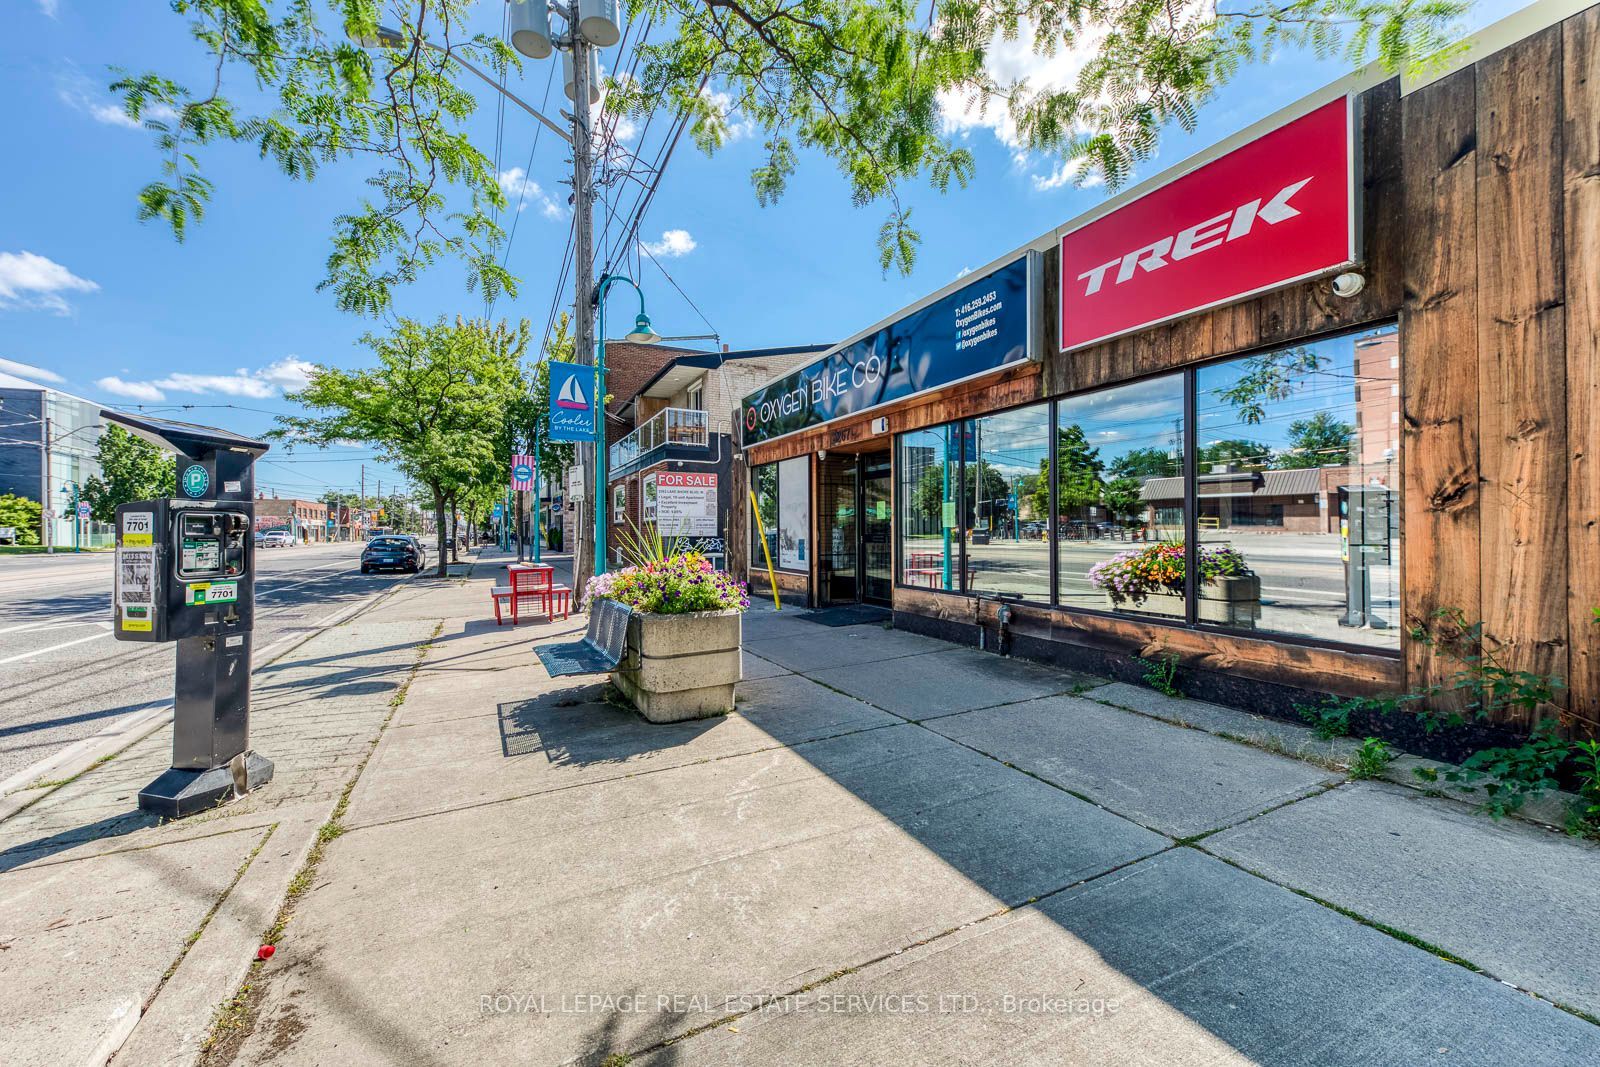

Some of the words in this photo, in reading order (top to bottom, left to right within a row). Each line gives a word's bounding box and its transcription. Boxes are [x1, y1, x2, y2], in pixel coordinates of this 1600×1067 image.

[1077, 176, 1314, 297] TREK
[955, 308, 961, 317] T:
[961, 291, 997, 314] 416.259.2453
[955, 302, 1003, 328] OxygenBikes.com
[961, 328, 998, 350] @oxygenbikes
[760, 385, 808, 423] OXYGEN
[812, 368, 848, 404] BIKE
[852, 355, 881, 389] CO
[551, 410, 592, 427] Cooler
[190, 473, 201, 487] P
[658, 475, 683, 485] FOR
[686, 476, 715, 486] SALE
[127, 521, 149, 531] 7701
[211, 590, 233, 598] 7701
